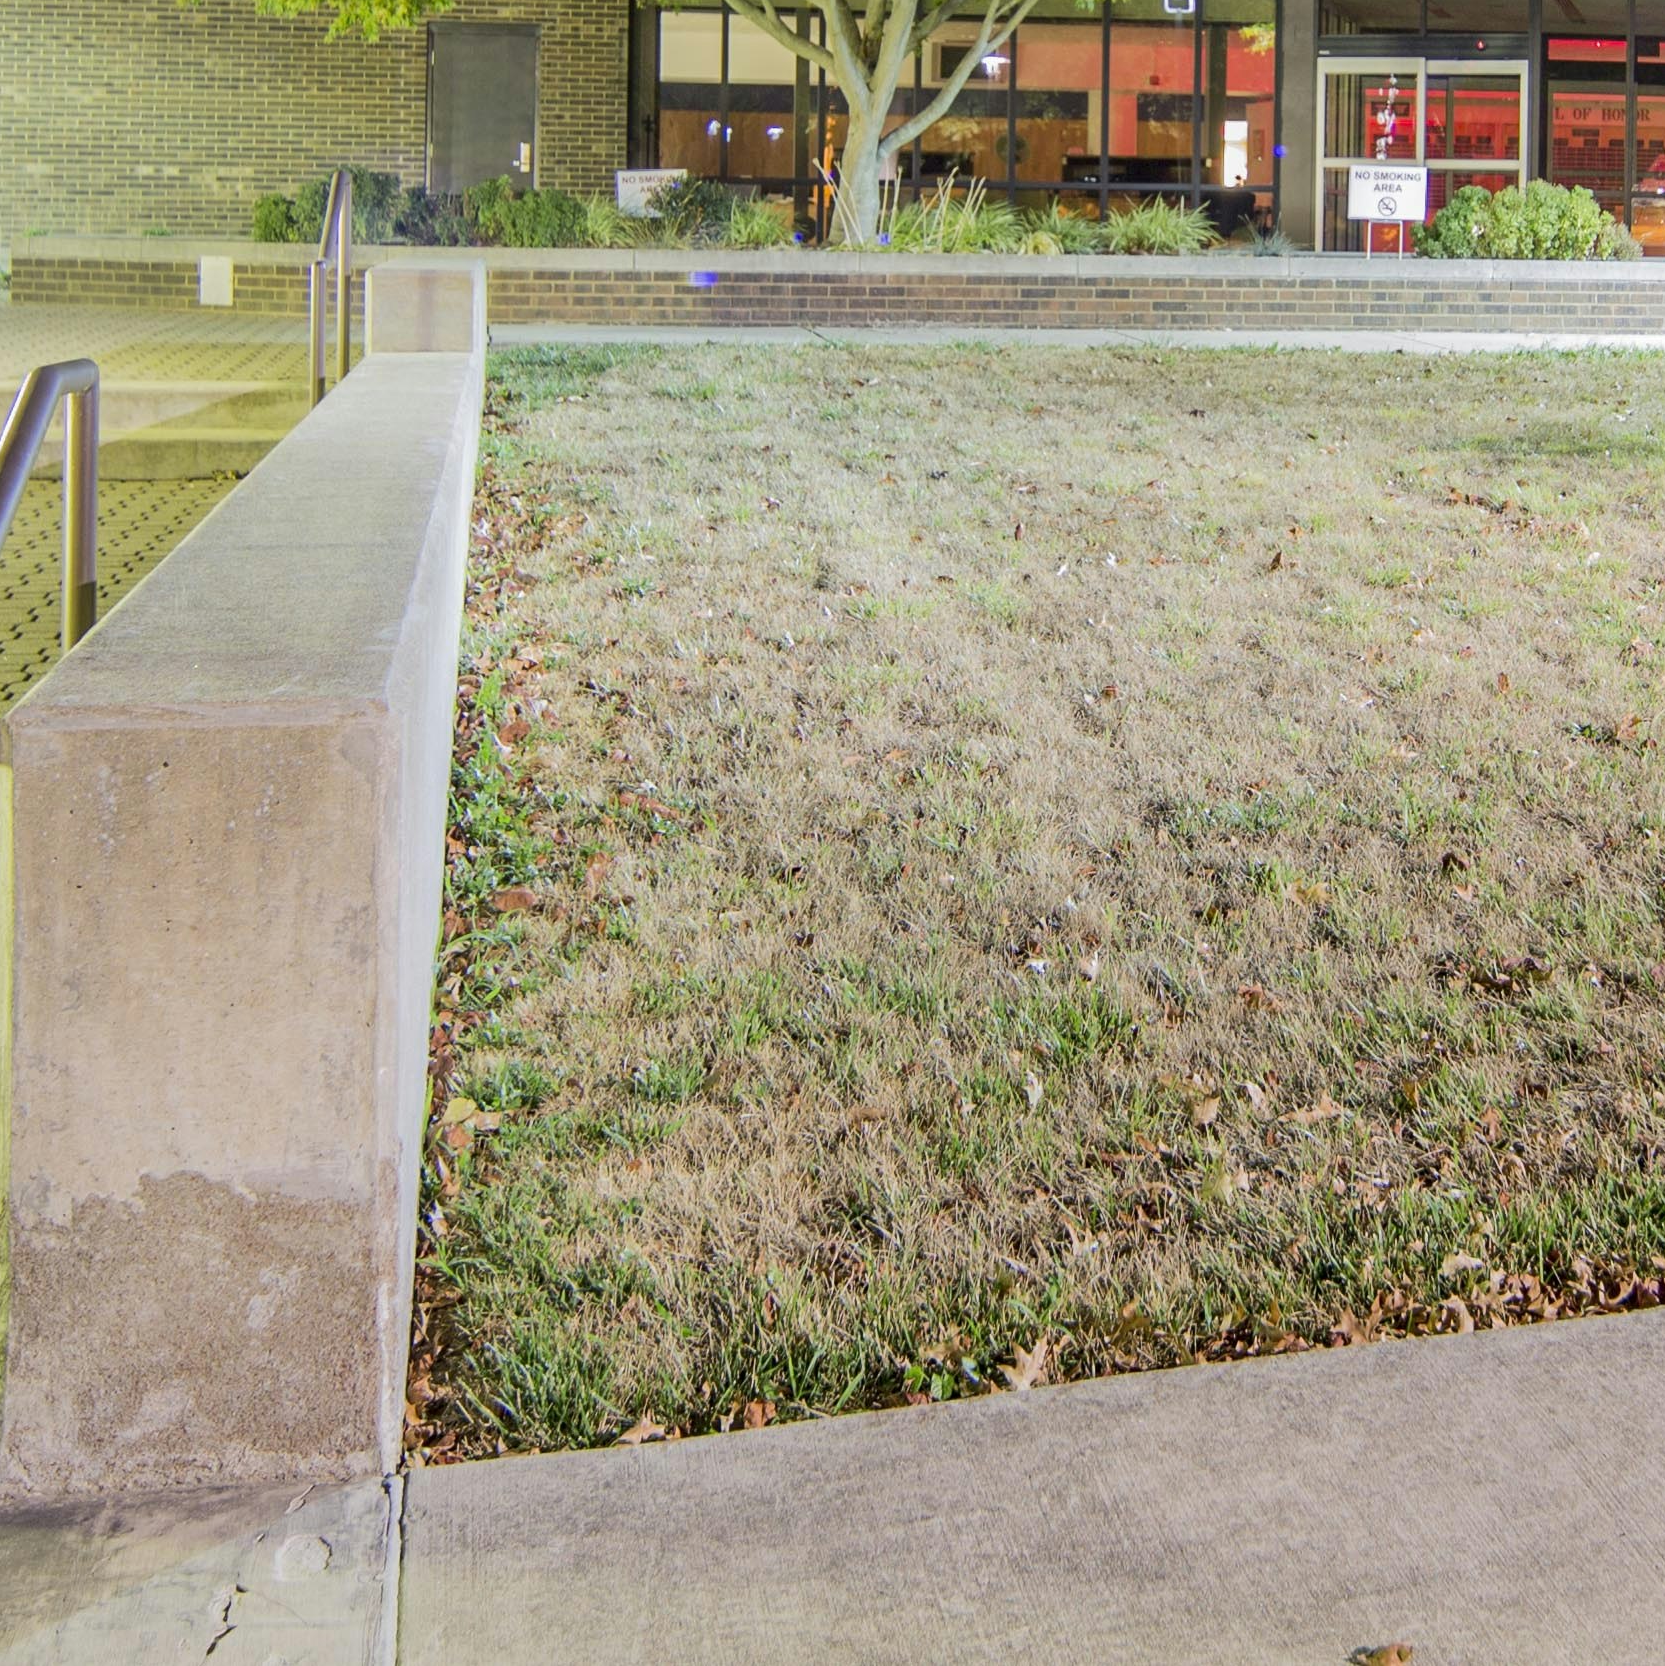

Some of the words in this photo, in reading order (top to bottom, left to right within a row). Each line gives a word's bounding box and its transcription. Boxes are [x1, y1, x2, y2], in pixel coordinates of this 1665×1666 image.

[1573, 107, 1592, 120] OF
[622, 175, 636, 185] NO
[1355, 171, 1371, 180] NO
[1374, 171, 1422, 182] SMOKING
[1374, 183, 1403, 193] AREA
